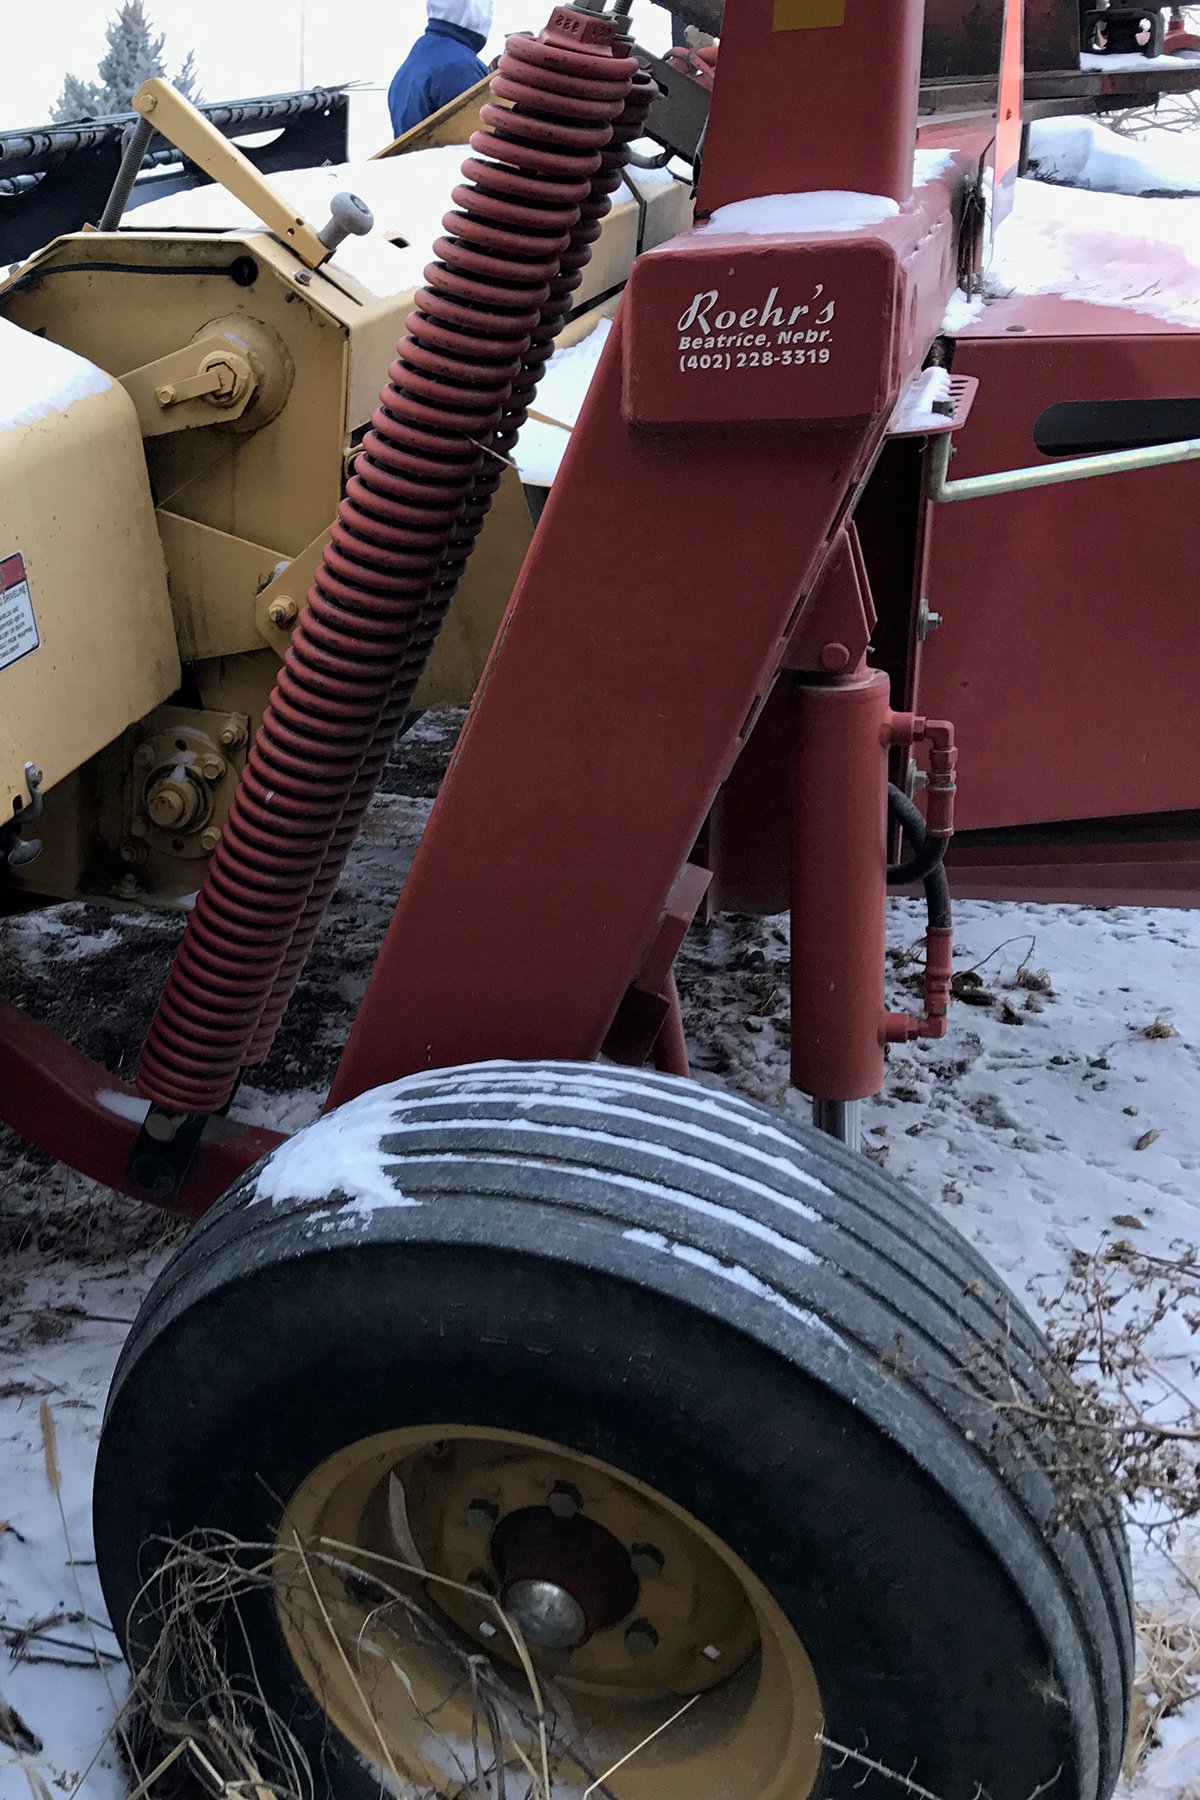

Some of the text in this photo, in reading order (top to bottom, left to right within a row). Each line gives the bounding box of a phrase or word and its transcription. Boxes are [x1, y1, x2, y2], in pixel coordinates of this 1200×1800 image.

[677, 283, 836, 335] Roehr's
[678, 328, 834, 350] Beatrice, Nebr.
[679, 348, 830, 373] (402) 228-3319
